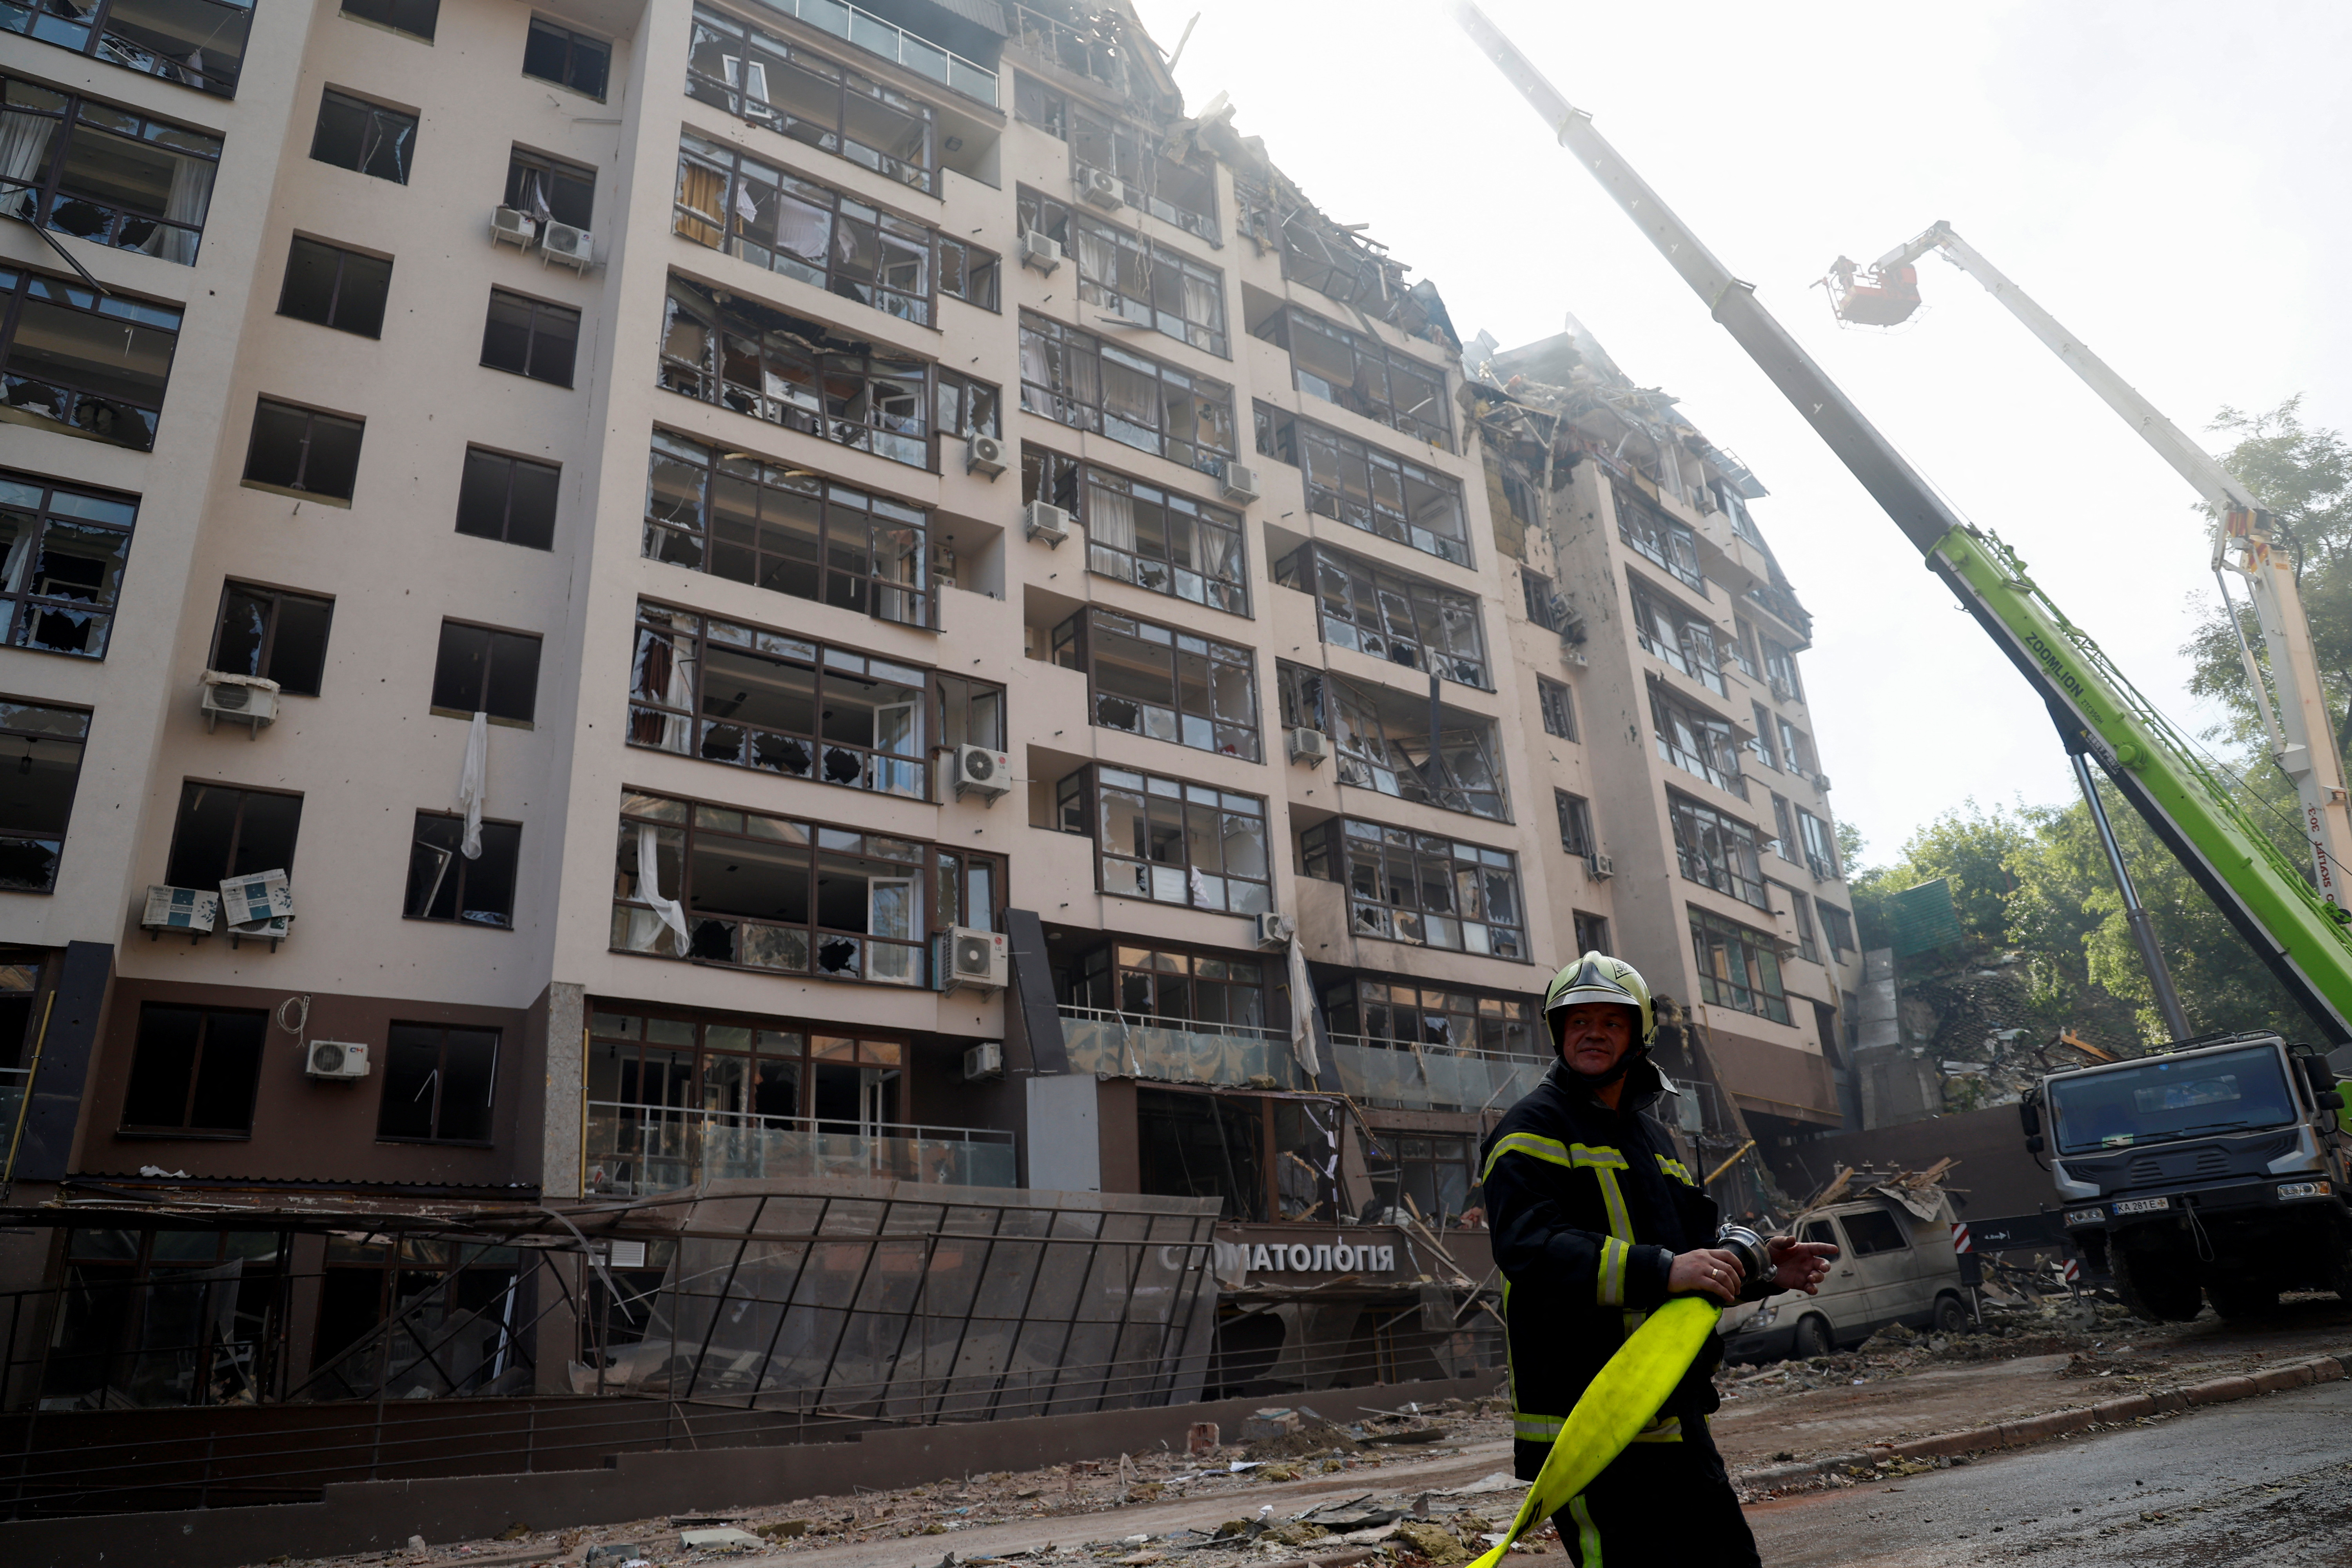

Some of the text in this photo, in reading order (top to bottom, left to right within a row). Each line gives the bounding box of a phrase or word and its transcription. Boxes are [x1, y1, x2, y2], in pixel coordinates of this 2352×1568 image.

[2025, 632, 2084, 697] ZOOMLION
[2315, 841, 2332, 888] SKYLIFT
[2118, 1203, 2131, 1212] KA
[2133, 1201, 2147, 1210] 281
